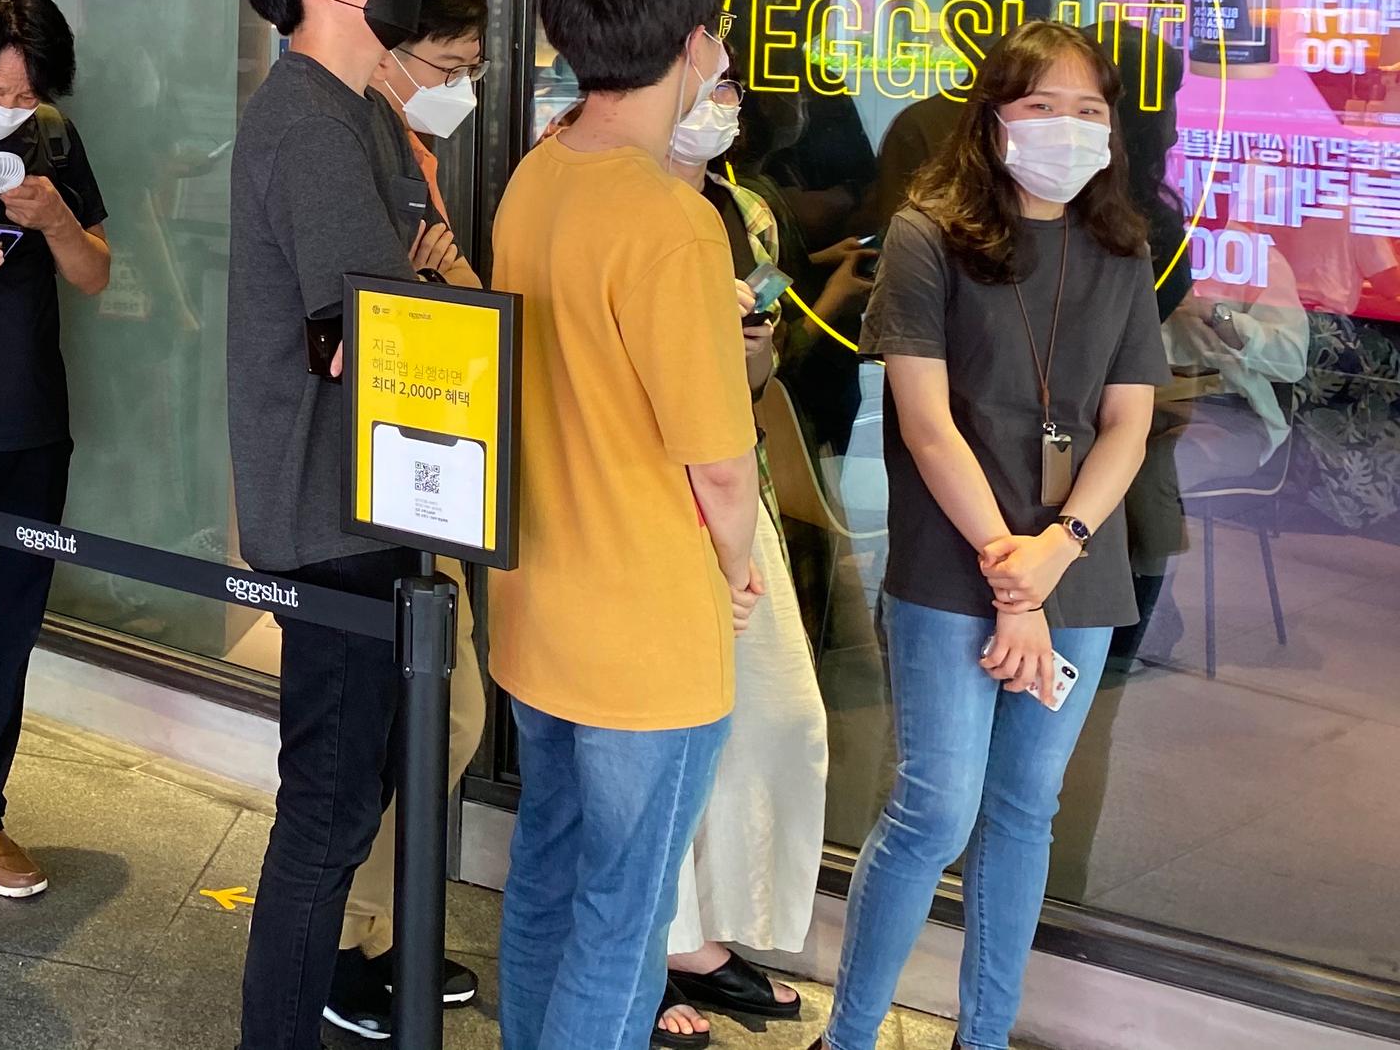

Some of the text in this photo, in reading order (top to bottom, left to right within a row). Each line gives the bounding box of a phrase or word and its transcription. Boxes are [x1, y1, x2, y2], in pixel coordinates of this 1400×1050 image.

[371, 338, 400, 358] 지금,
[371, 356, 463, 386] 해피앱 실행하면
[371, 376, 470, 407] 최대 2,000P 혜택
[16, 524, 77, 555] eggslut
[225, 573, 299, 609] eggslut
